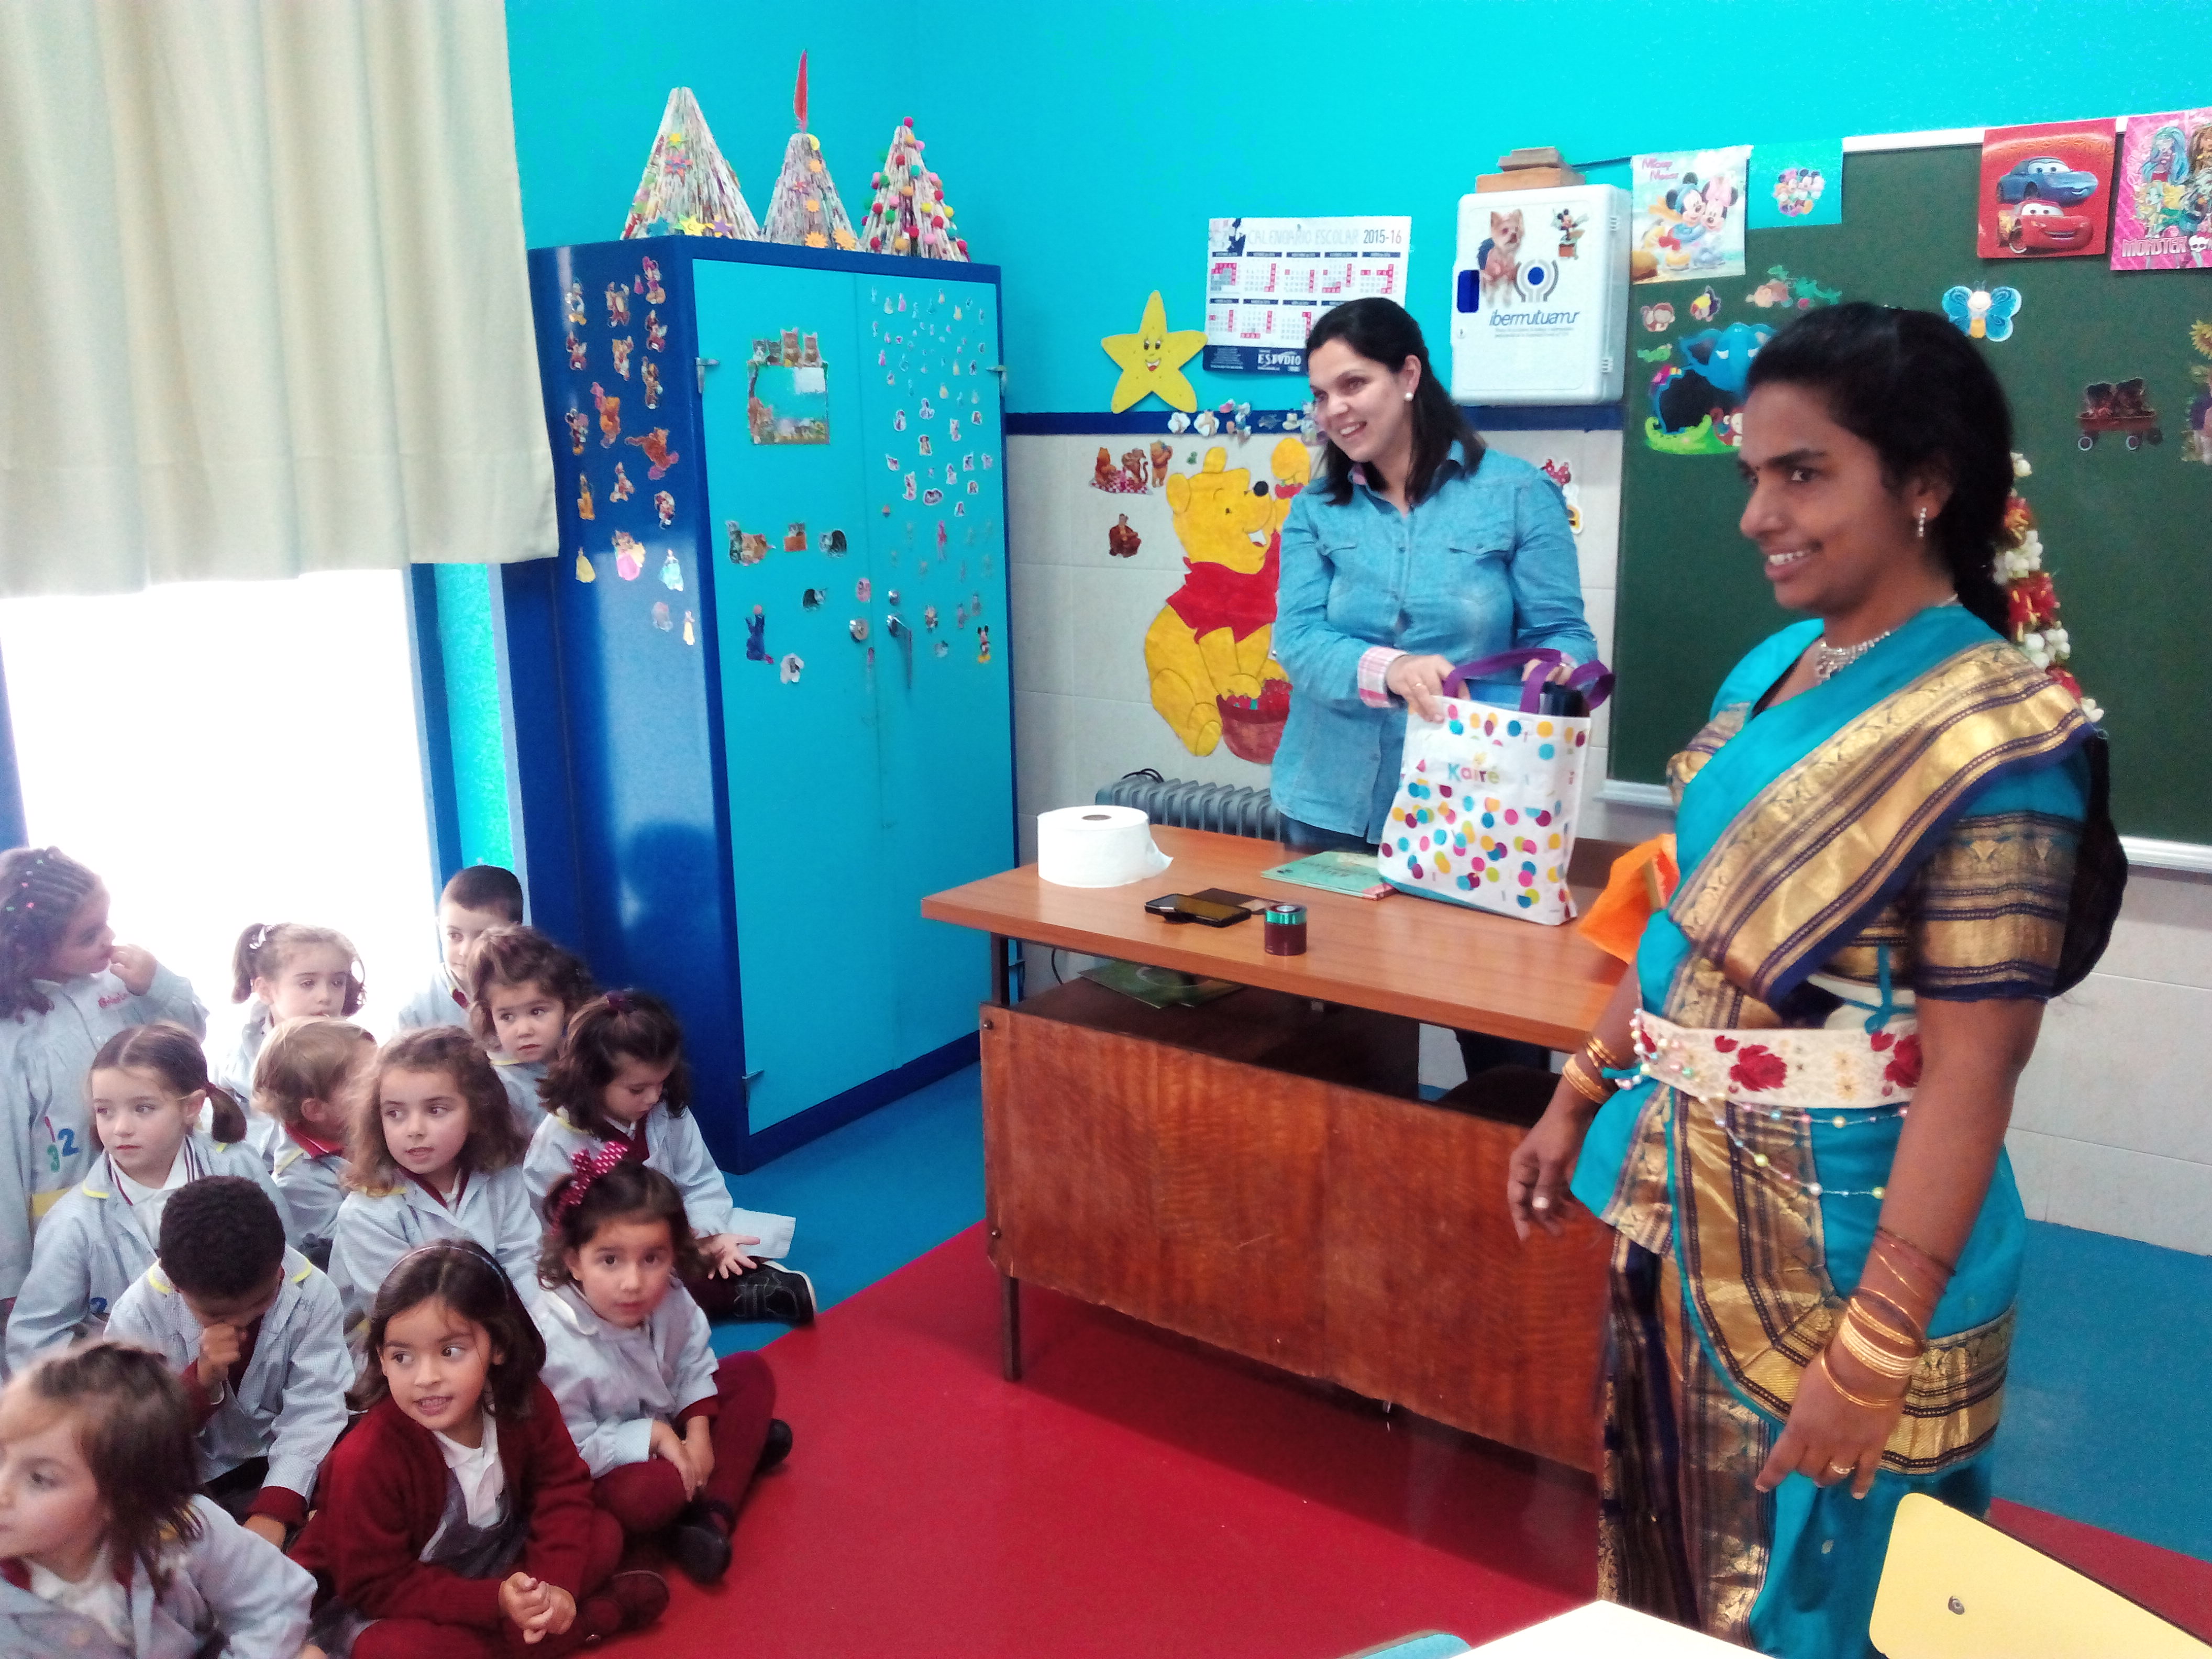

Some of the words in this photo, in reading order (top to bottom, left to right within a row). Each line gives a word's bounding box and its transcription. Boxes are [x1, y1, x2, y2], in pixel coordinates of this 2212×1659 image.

[1315, 229, 1359, 245] ESCOLAR
[1363, 229, 1402, 245] 2015-16
[2122, 236, 2187, 258] MONSTER
[1489, 309, 1580, 326] ibermutuamur
[57, 1127, 79, 1157] 2
